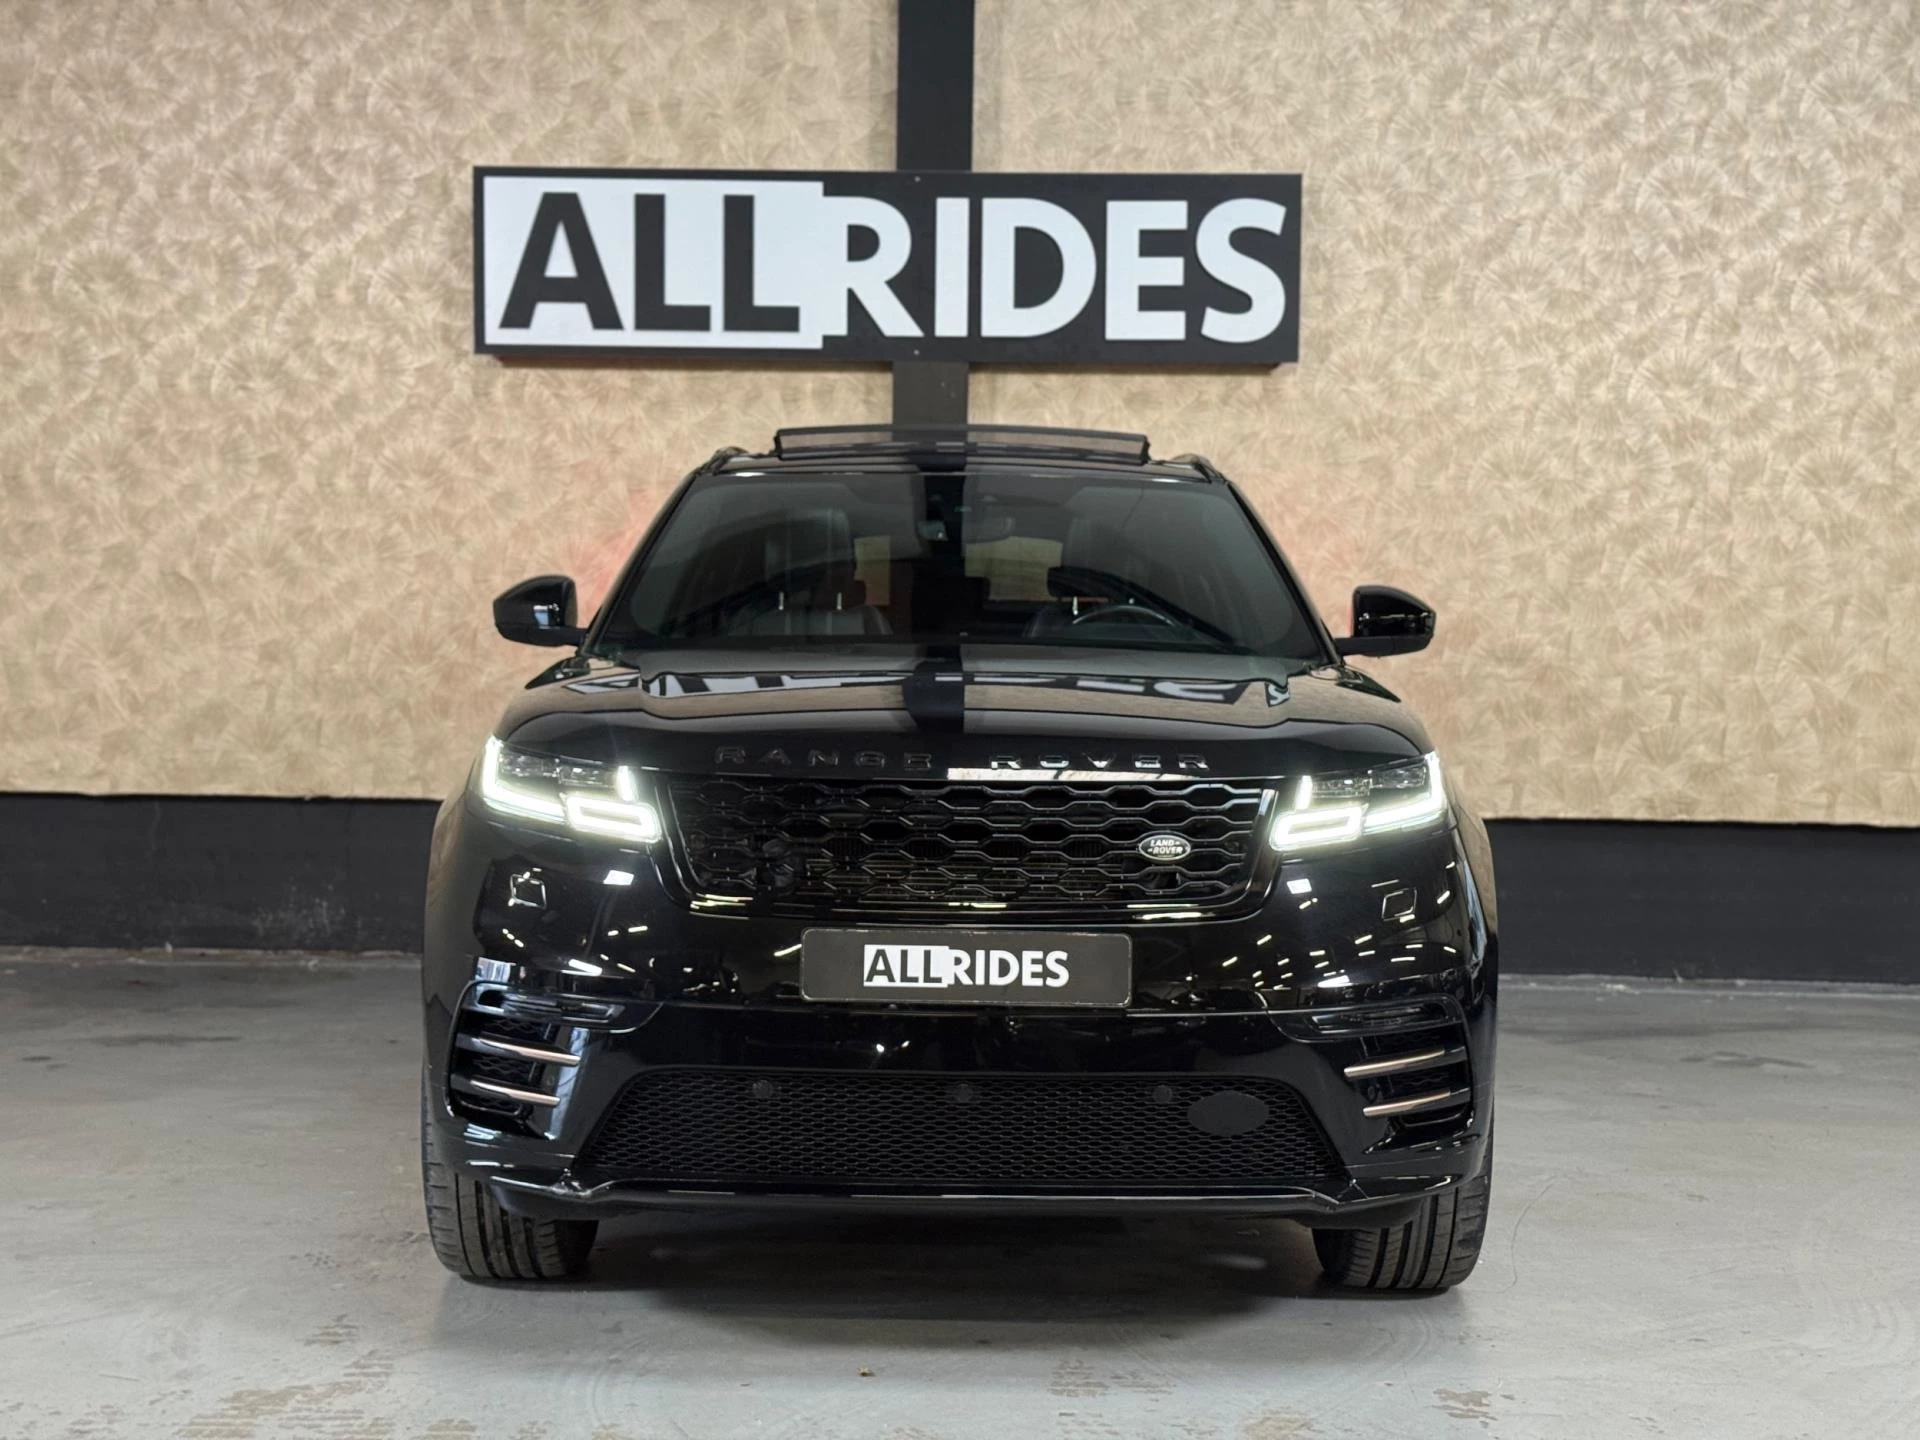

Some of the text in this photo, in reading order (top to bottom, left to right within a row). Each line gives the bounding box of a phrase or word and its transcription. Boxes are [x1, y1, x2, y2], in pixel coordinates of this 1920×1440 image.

[498, 191, 1288, 344] ALLRIDES
[714, 745, 1210, 772] RANGE ROVER
[865, 948, 1070, 987] ALLRIDES
